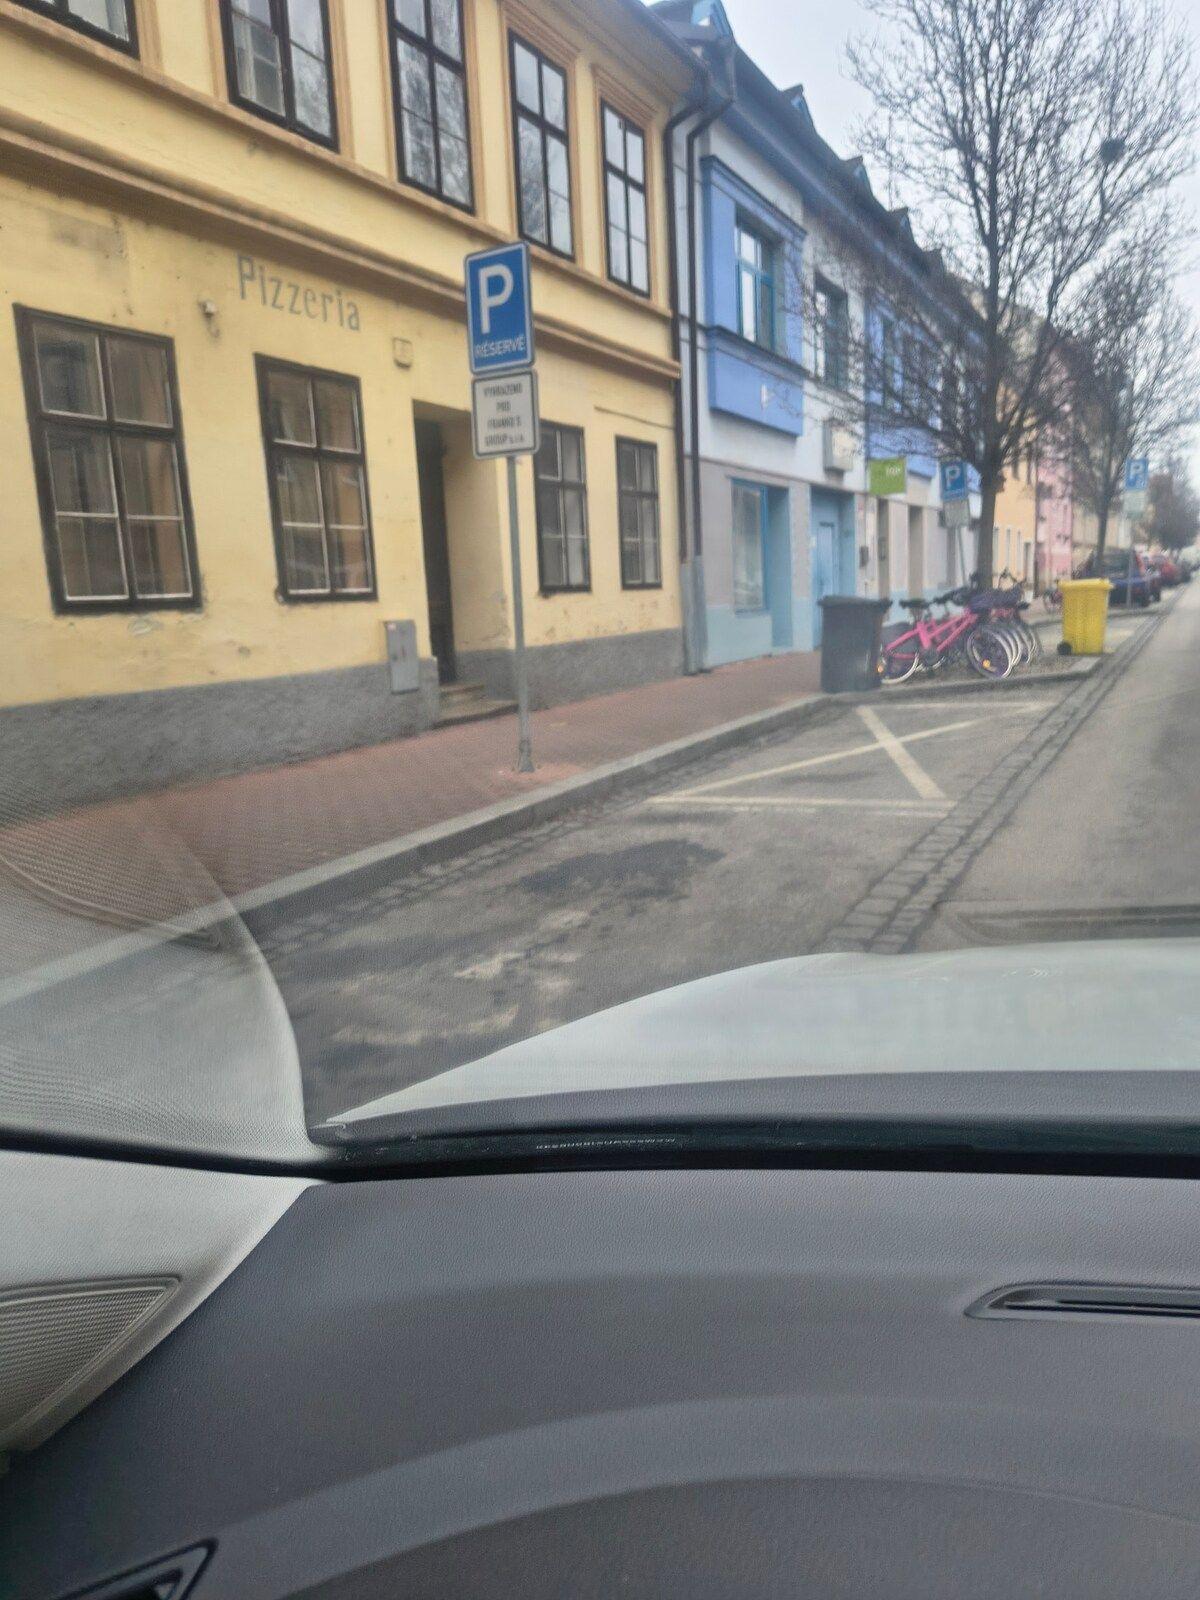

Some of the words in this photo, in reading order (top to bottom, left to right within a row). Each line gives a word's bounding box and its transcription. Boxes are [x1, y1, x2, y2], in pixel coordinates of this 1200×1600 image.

[239, 253, 359, 331] Pizzeria
[479, 264, 514, 333] P
[945, 465, 961, 490] P
